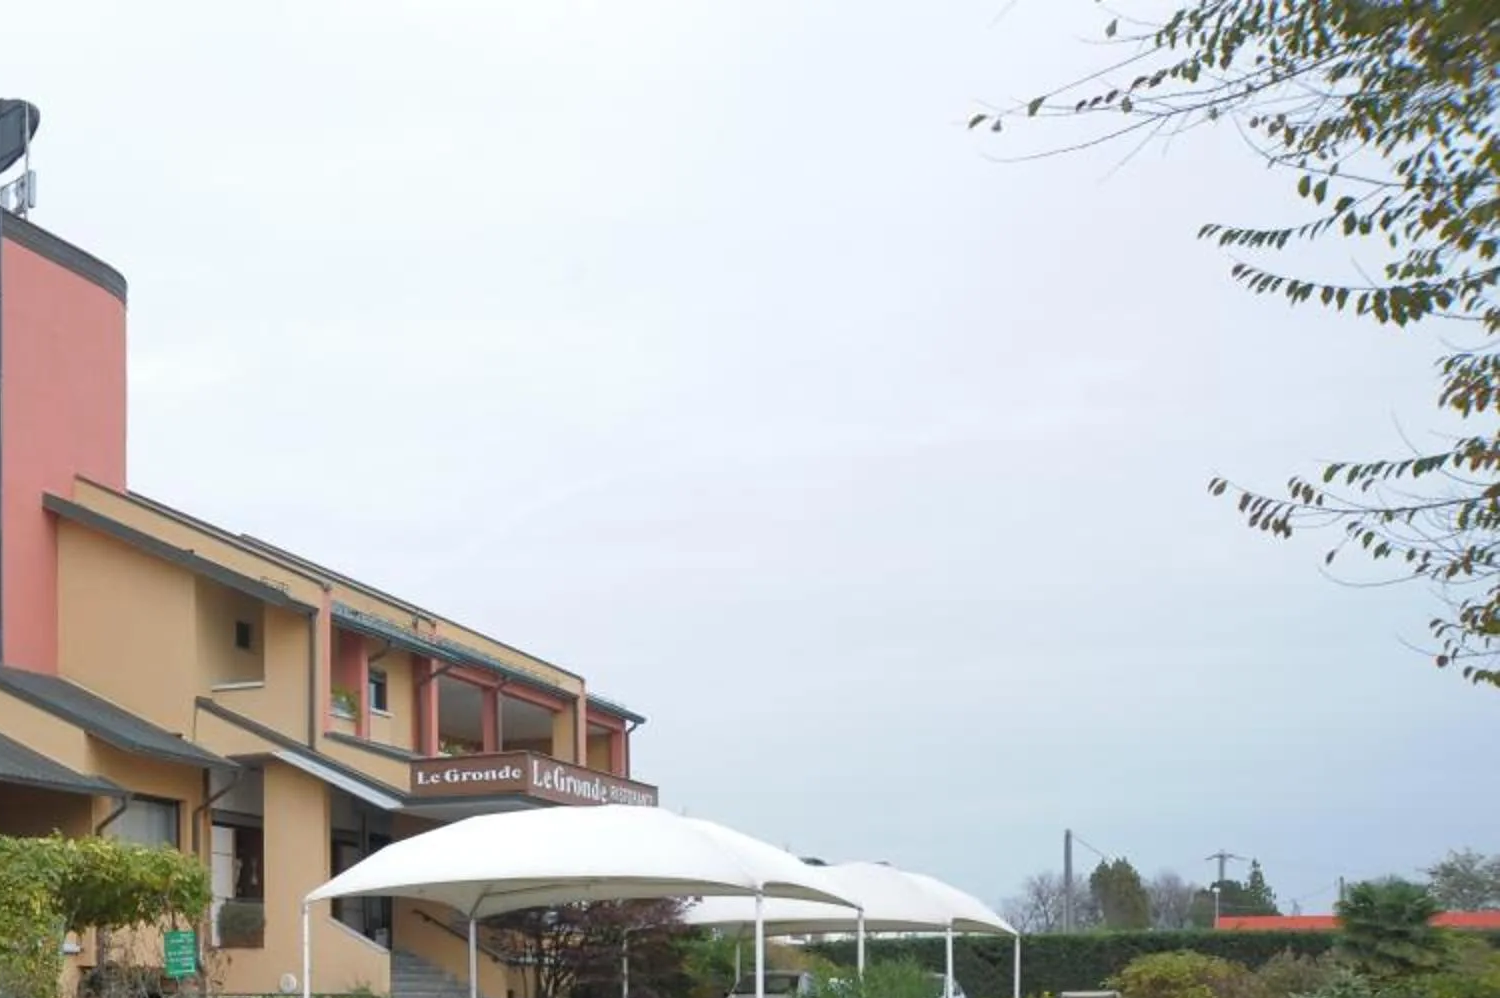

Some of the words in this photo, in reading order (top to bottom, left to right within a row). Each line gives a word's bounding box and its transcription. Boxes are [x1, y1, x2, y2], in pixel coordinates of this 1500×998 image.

[417, 771, 440, 785] Le
[444, 765, 522, 783] Gronde
[532, 760, 552, 789] Le
[553, 766, 607, 802] Gronde
